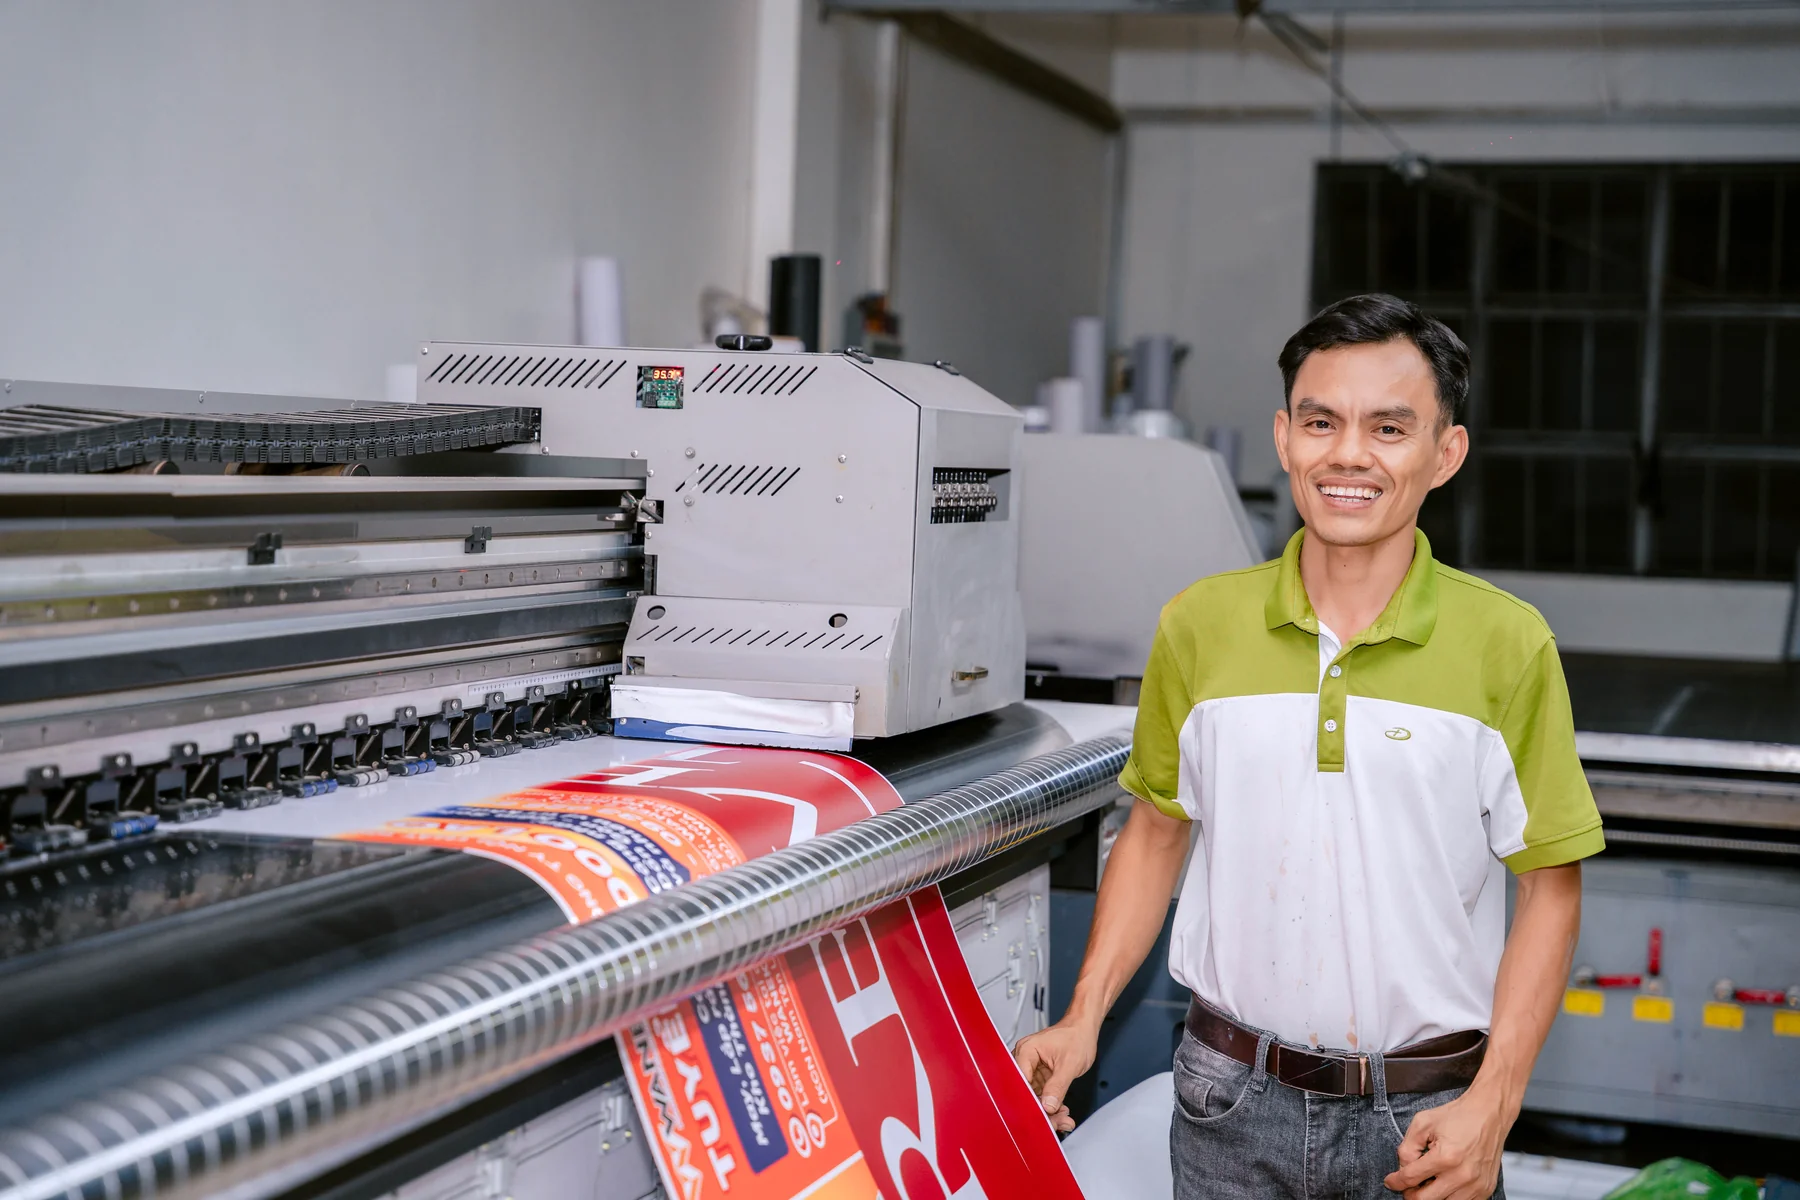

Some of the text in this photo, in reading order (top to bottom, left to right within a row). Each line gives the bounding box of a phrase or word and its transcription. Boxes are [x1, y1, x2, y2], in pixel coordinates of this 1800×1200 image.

[751, 1020, 795, 1111] 0937
[787, 1010, 809, 1053] Nam
[630, 1024, 674, 1134] WANE
[653, 1006, 736, 1191] TUYỂ
[744, 1061, 771, 1116] Kho
